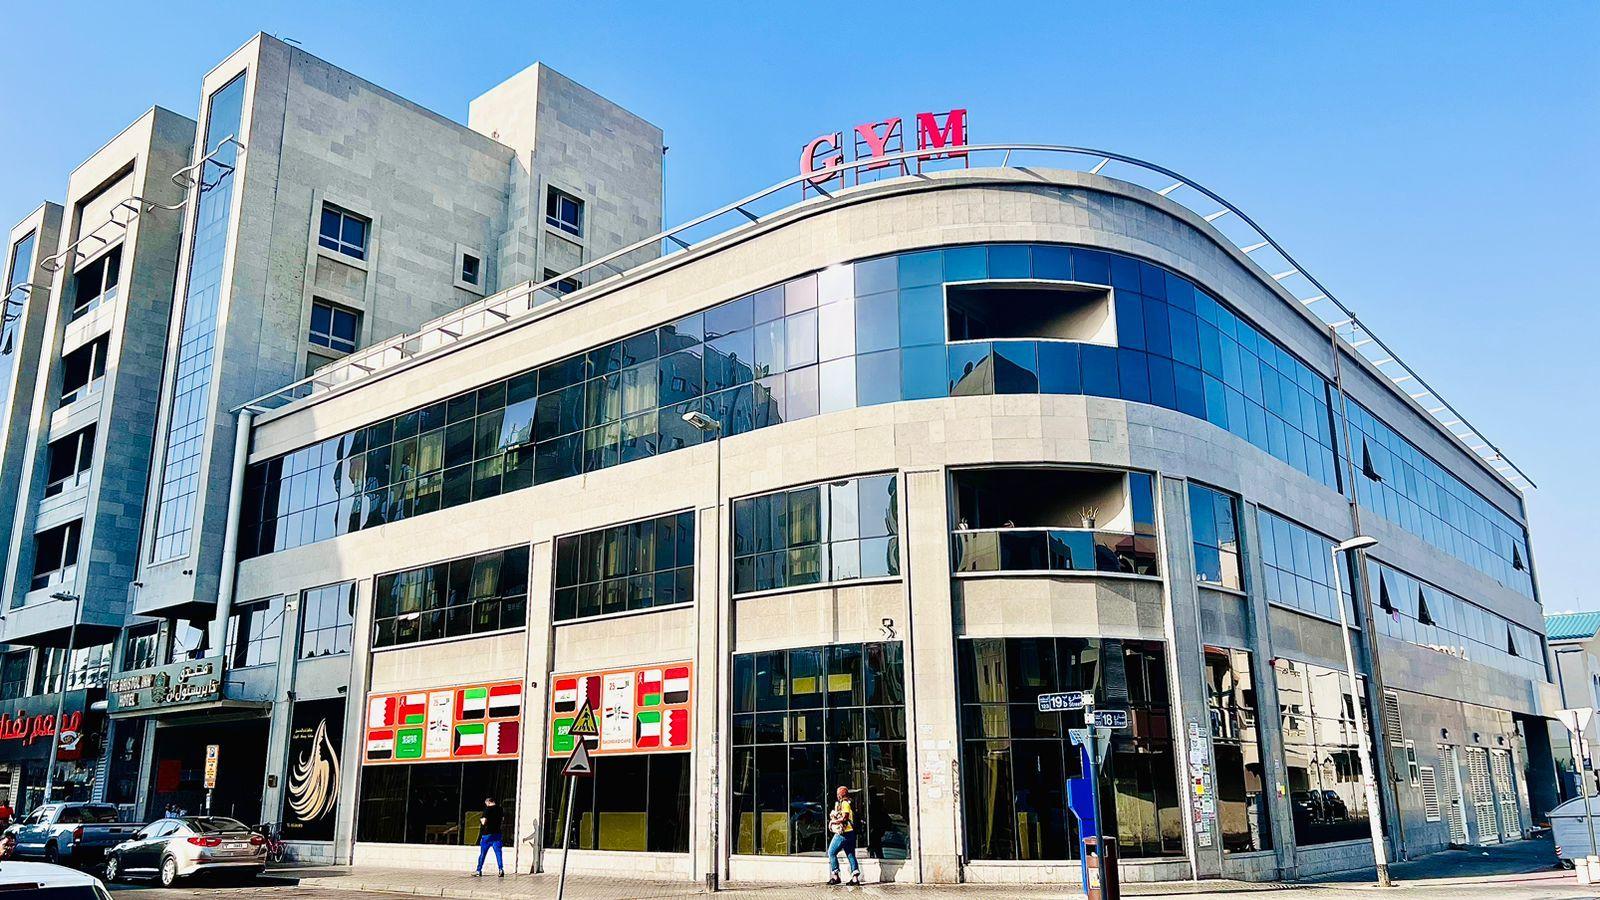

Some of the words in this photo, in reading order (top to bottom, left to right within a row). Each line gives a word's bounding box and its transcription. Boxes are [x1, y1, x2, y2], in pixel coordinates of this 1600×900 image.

[799, 108, 969, 185] GYM
[1050, 696, 1062, 708] 19
[1102, 714, 1113, 726] 18
